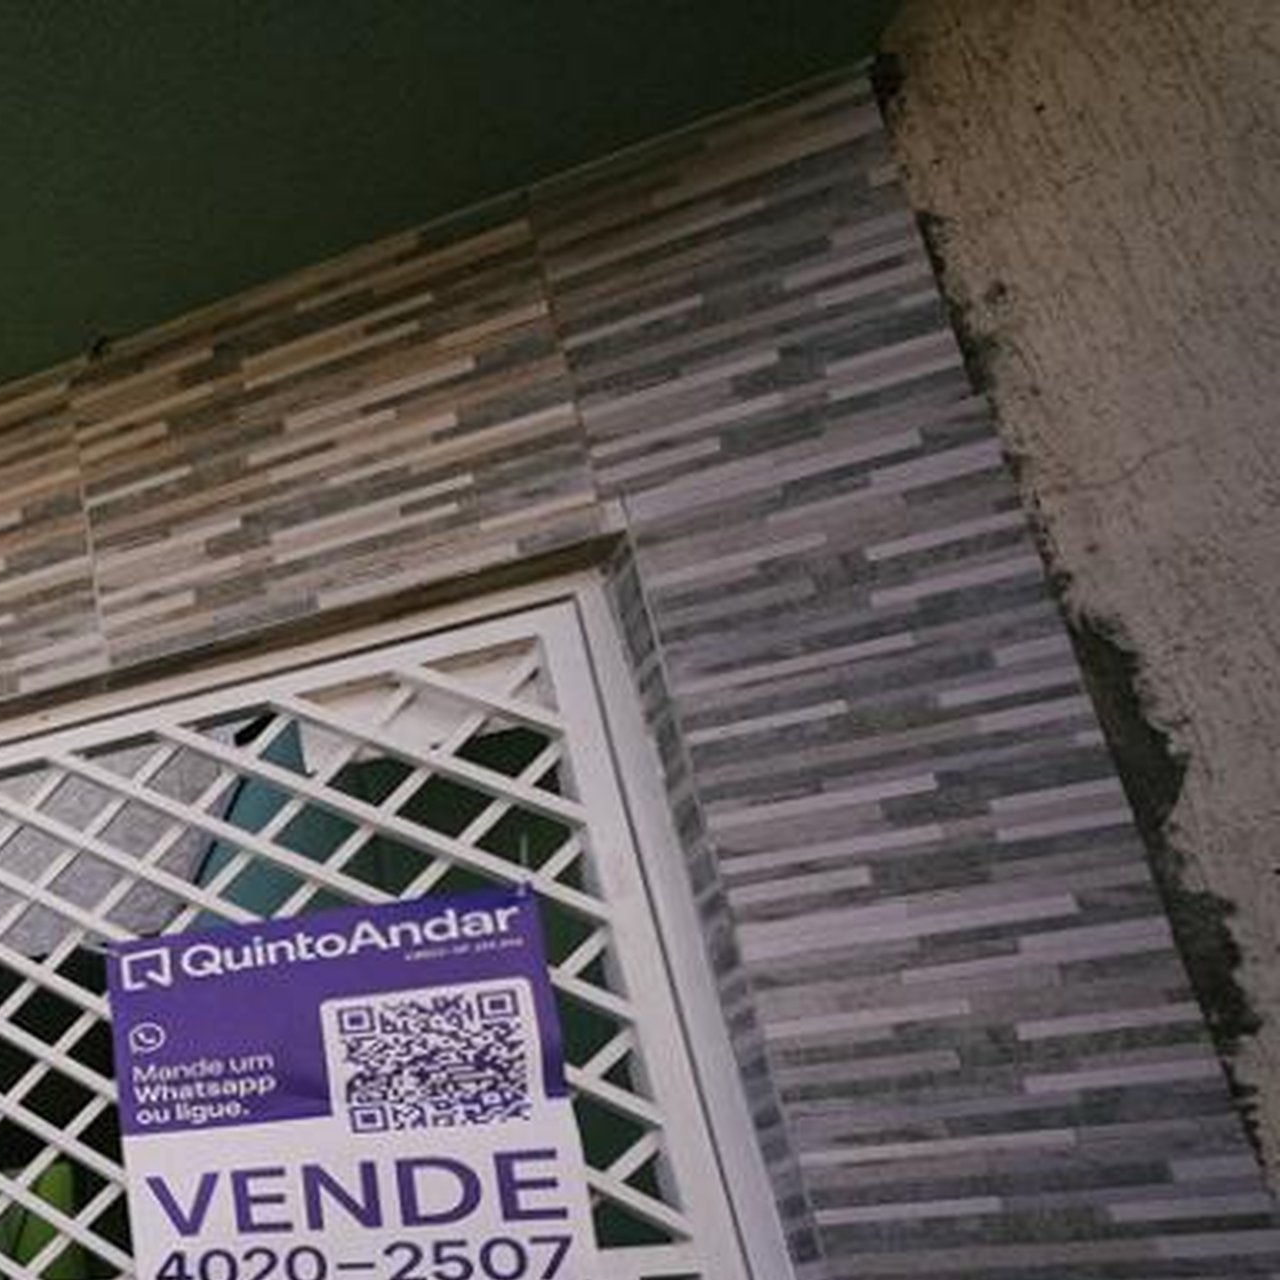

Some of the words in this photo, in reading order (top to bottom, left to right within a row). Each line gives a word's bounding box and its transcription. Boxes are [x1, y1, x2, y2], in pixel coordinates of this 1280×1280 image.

[181, 905, 520, 977] QuintoAndar
[132, 1057, 224, 1083] Mande
[229, 1054, 275, 1074] um
[134, 1075, 276, 1103] Whatsapp
[136, 1108, 171, 1125] ou
[175, 1101, 251, 1125] ligue.
[145, 1148, 569, 1238] VENDE
